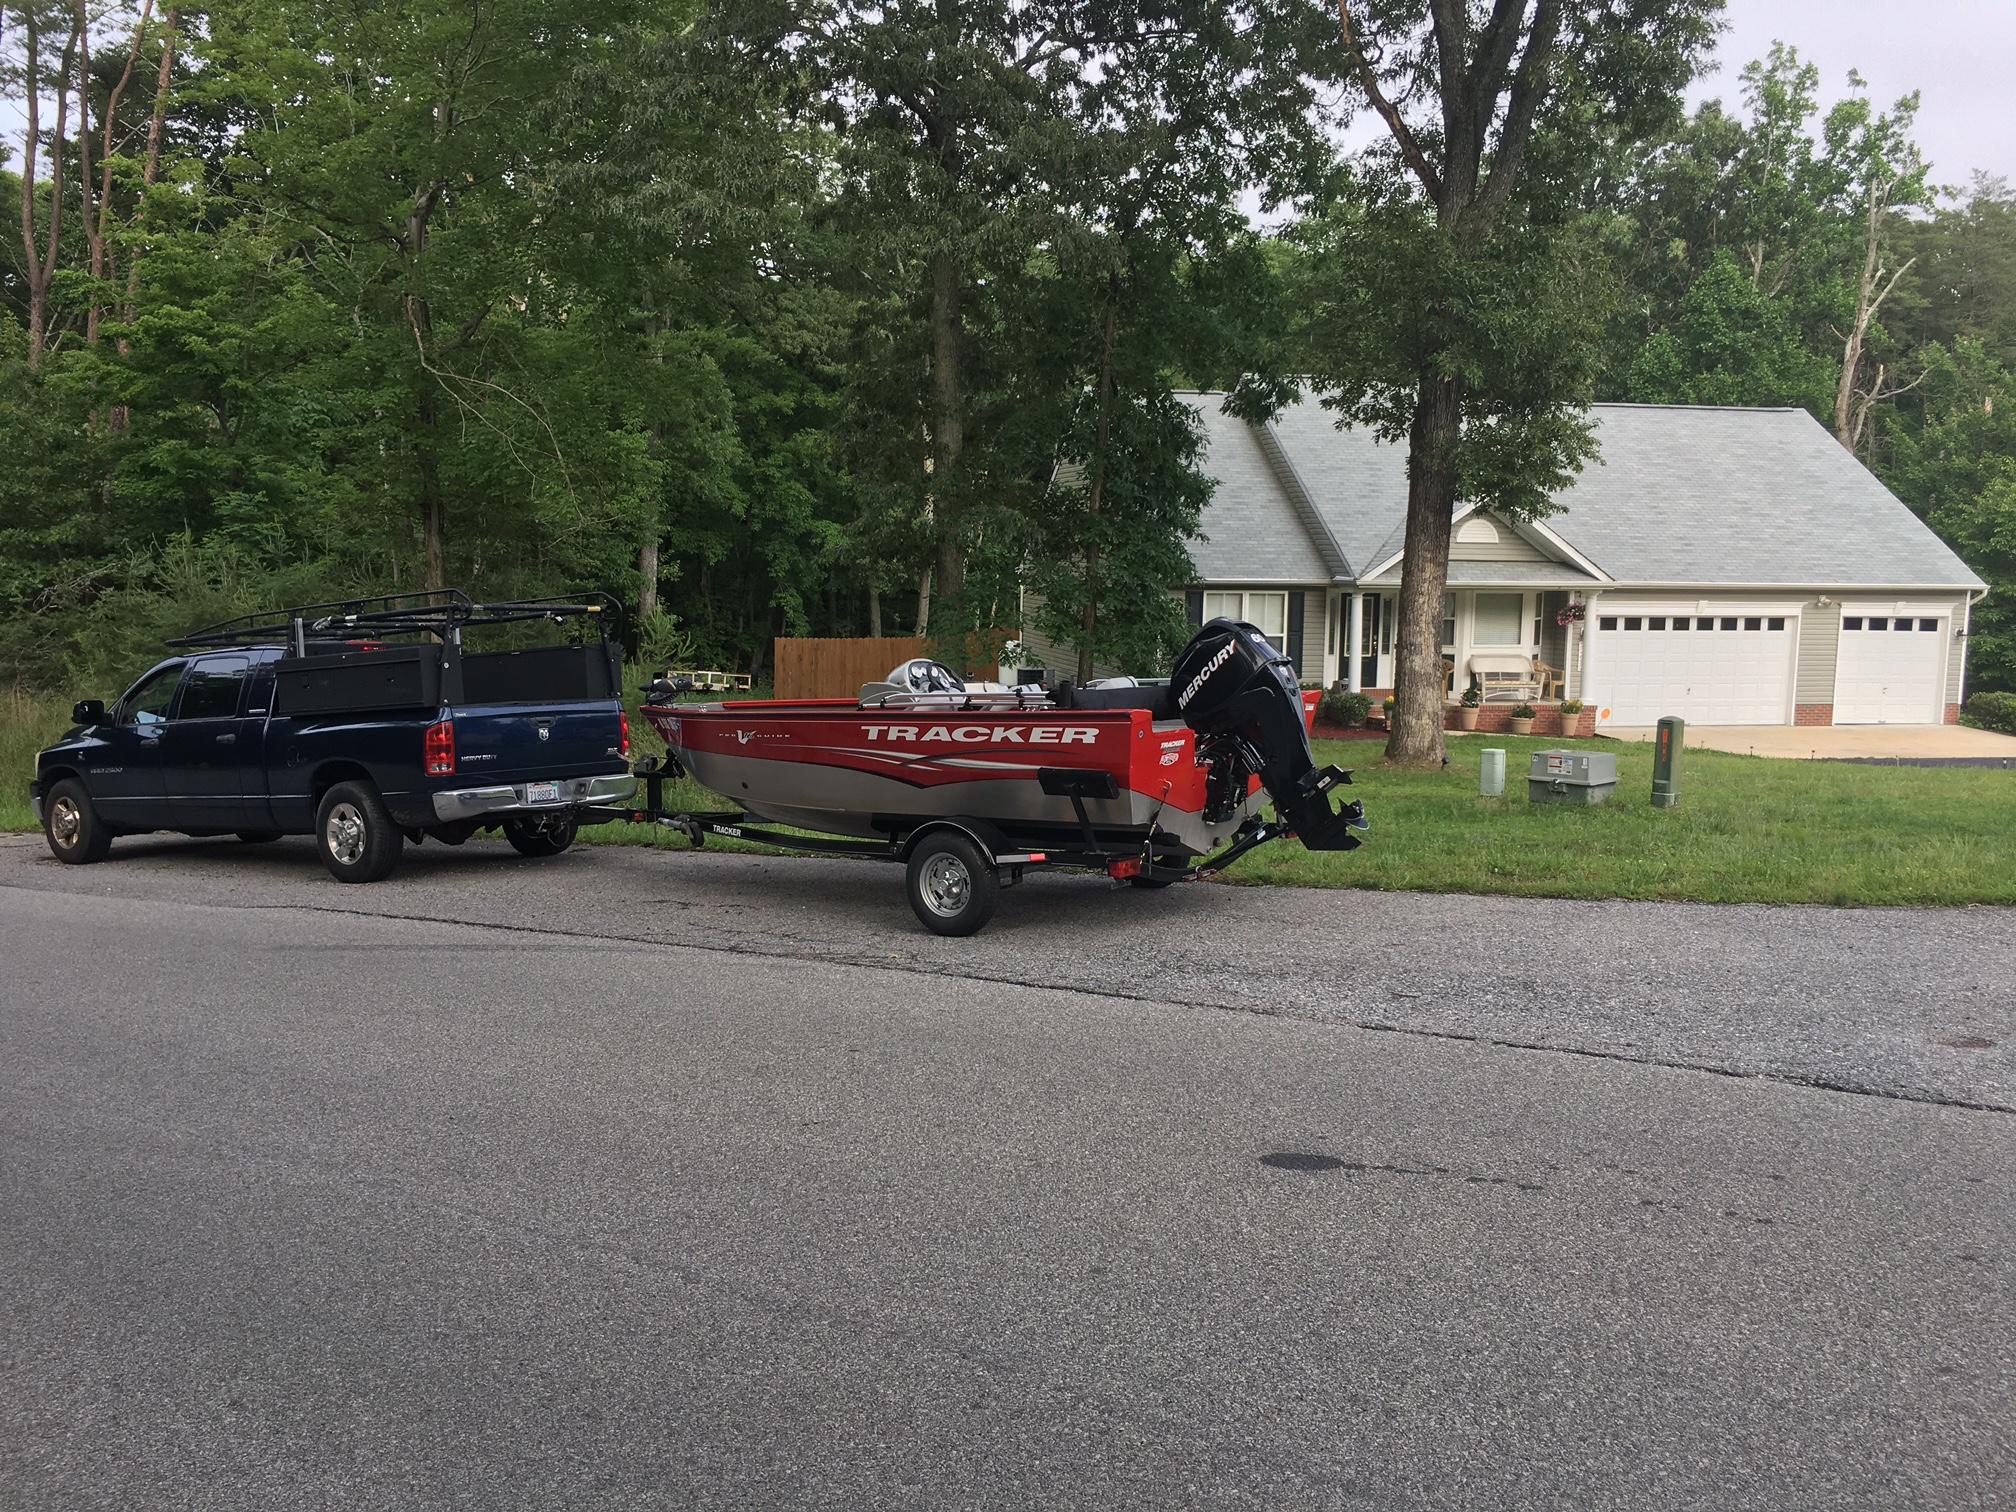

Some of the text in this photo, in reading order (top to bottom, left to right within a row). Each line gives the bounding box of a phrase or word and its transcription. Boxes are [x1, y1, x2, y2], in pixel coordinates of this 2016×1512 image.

[1178, 639, 1237, 710] MERCURY
[861, 725, 1099, 744] TRACKER
[1160, 739, 1186, 749] TRACKER
[713, 824, 741, 837] TRACKER
